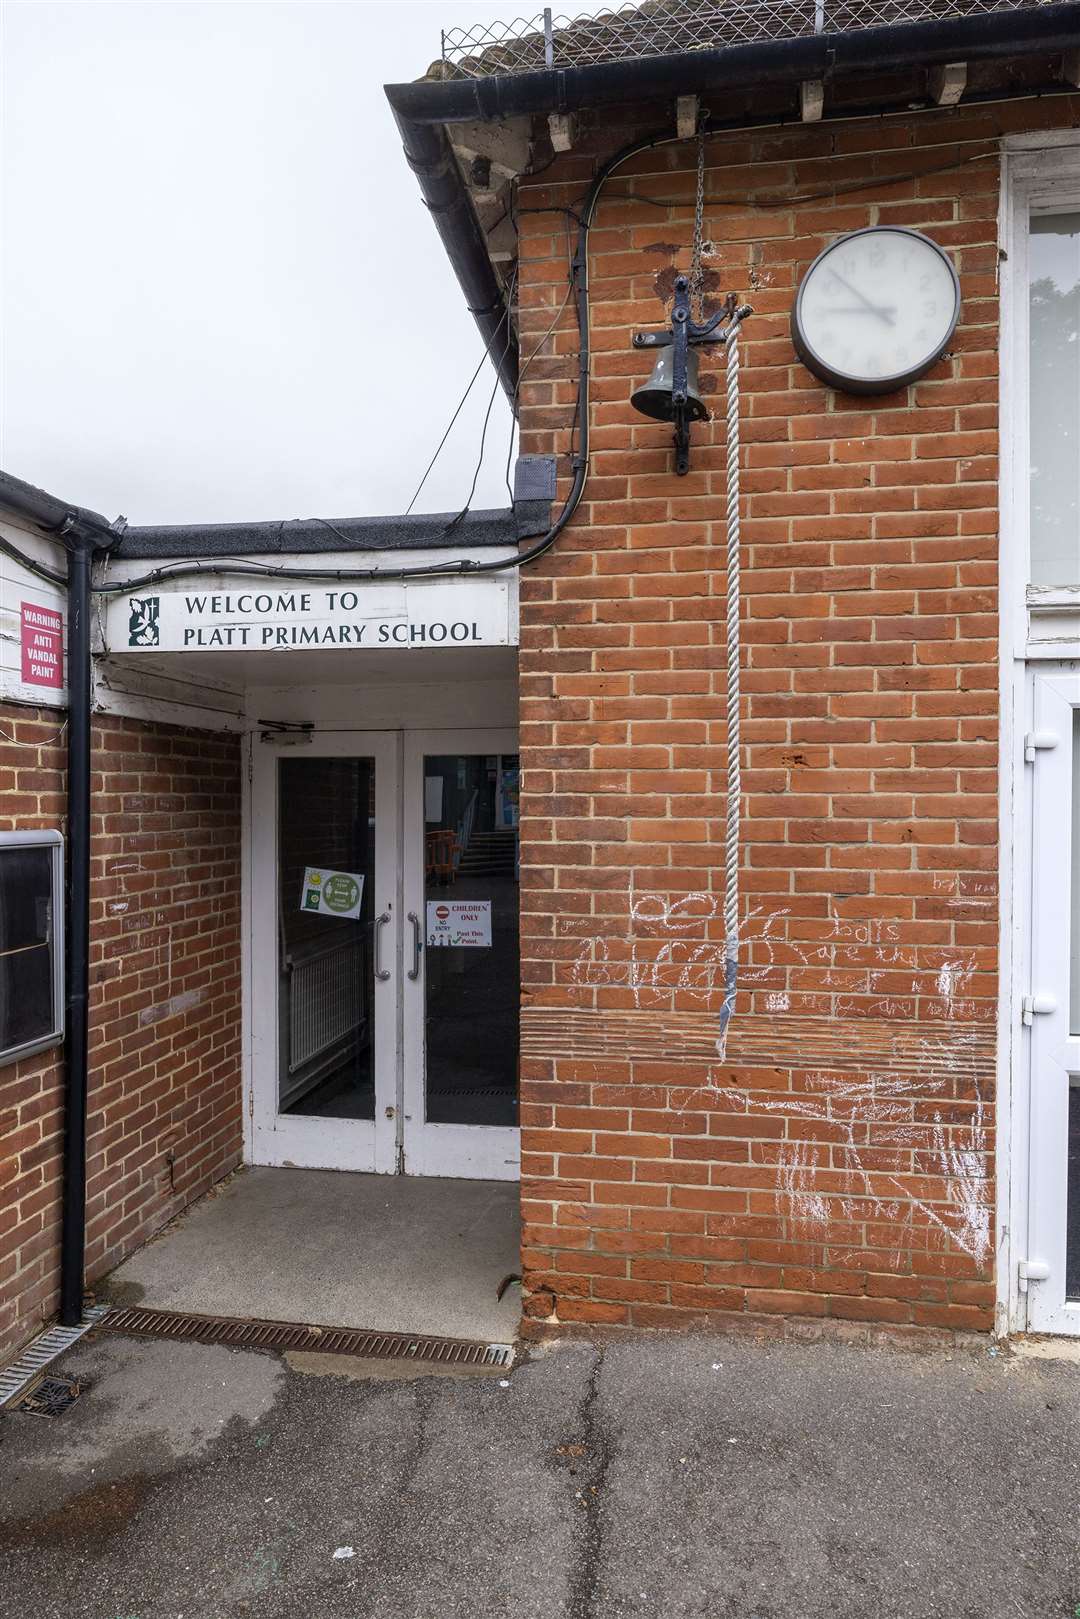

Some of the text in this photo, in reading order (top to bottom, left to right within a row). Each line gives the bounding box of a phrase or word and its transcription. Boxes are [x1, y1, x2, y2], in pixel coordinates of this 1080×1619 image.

[185, 592, 358, 614] WELCOME TO
[24, 610, 61, 629] WARNING
[34, 634, 52, 648] ANTI
[184, 622, 483, 645] PLATT PRIMARY SCHOOL
[27, 648, 58, 665] VANDAL
[31, 664, 54, 679] PAINT
